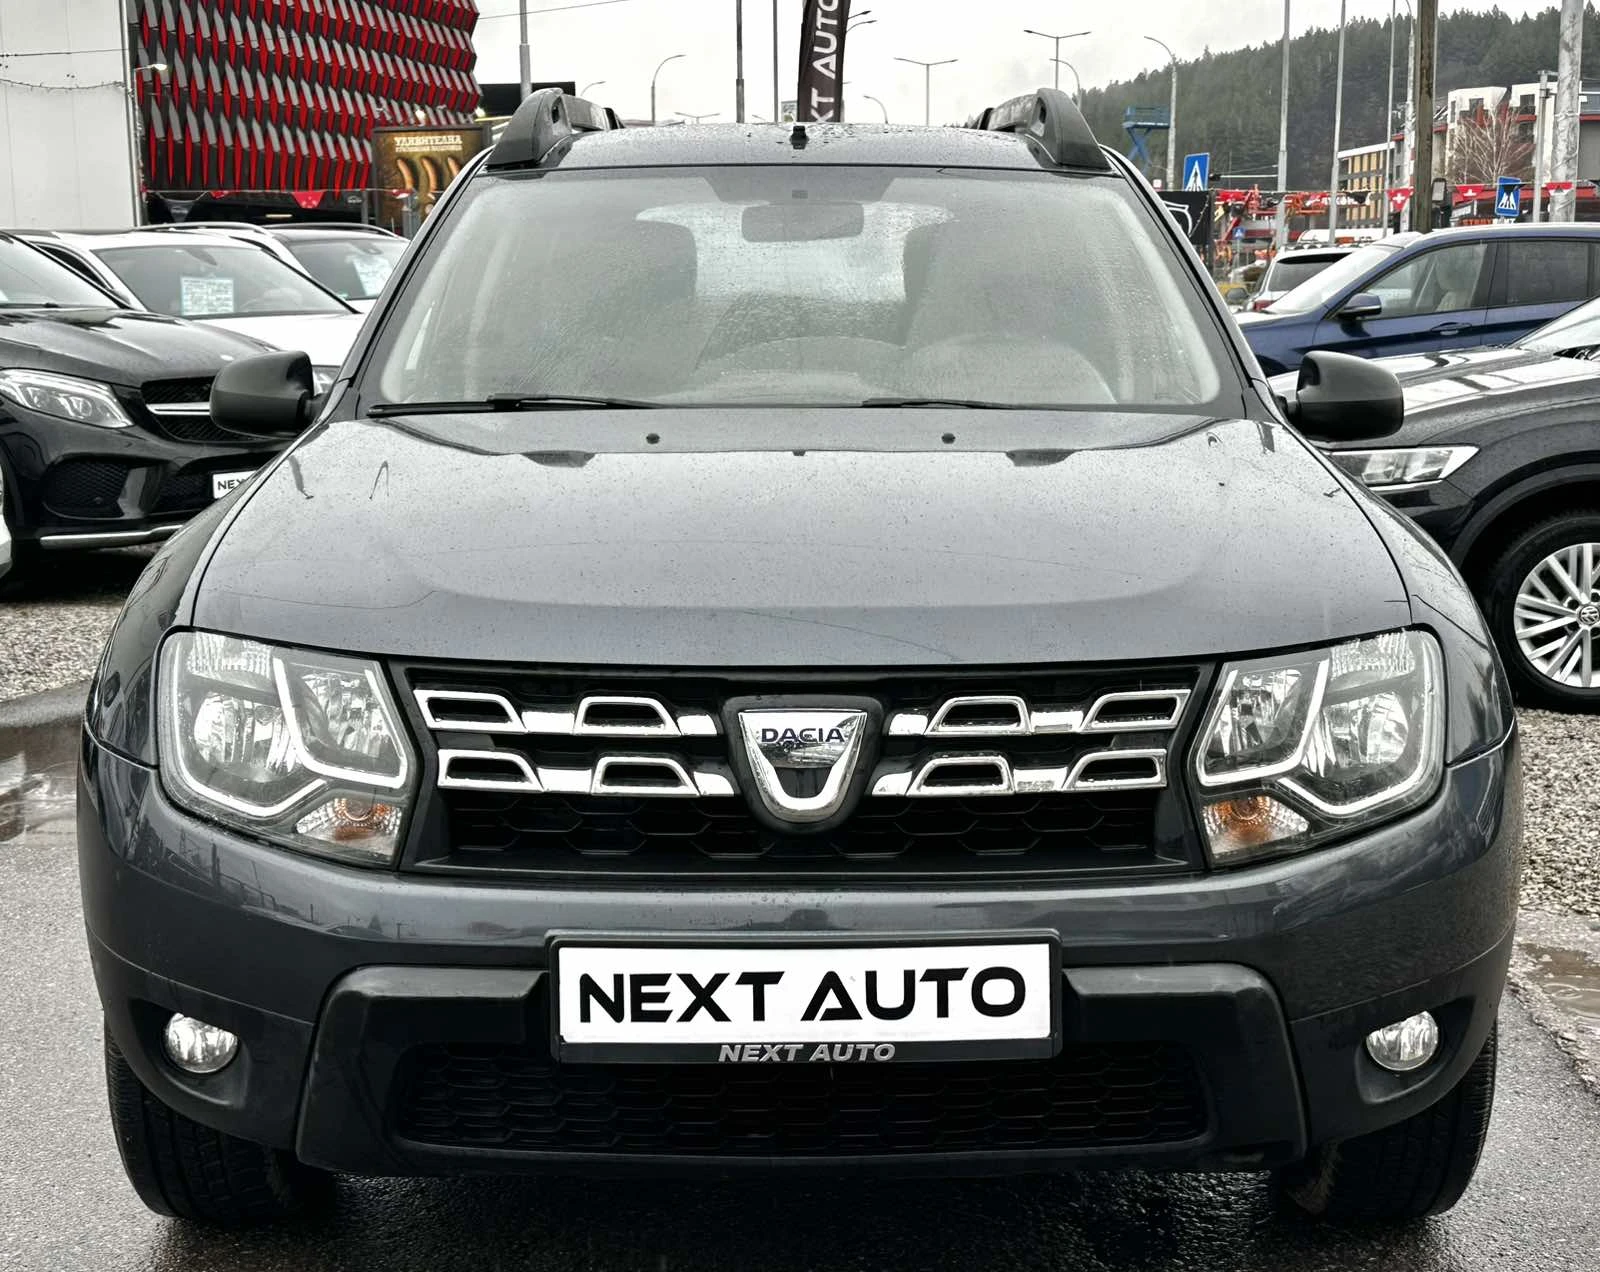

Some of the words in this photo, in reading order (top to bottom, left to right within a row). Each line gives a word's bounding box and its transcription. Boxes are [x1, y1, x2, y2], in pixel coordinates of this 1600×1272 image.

[762, 728, 845, 744] DACIA
[580, 972, 785, 1022] NEXT
[801, 966, 1025, 1021] AUTO
[719, 1043, 804, 1063] NEXT
[809, 1043, 896, 1062] AUTO
